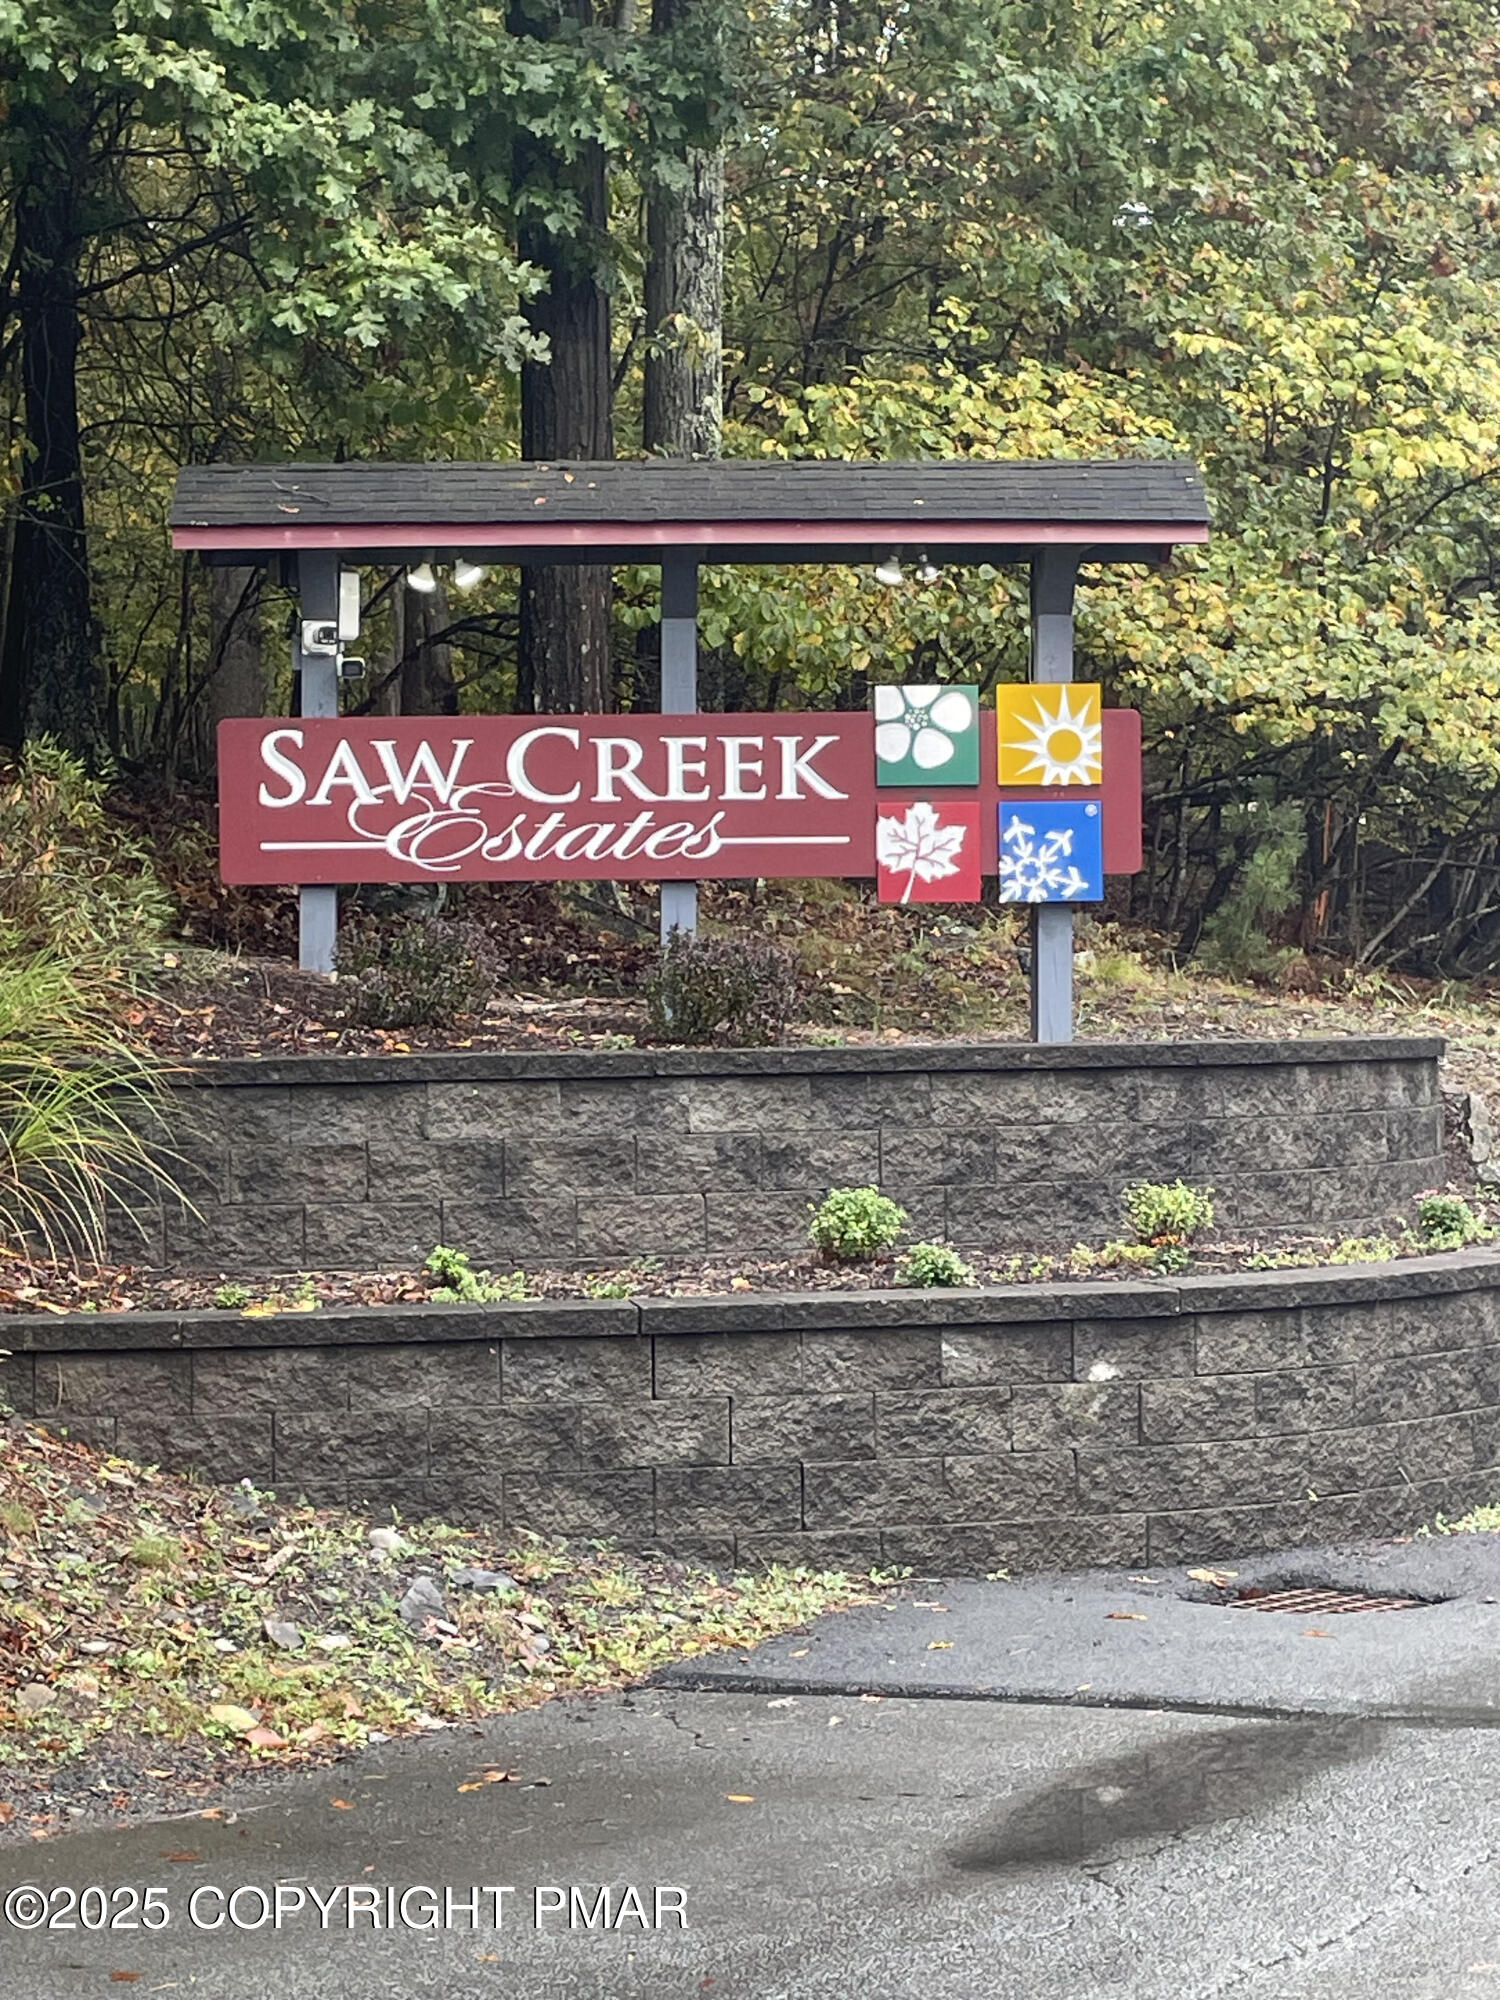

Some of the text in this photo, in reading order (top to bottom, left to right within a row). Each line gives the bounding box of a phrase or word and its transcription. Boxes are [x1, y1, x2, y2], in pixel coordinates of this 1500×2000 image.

[258, 726, 850, 809] SAW CREEK
[347, 782, 726, 872] Estates
